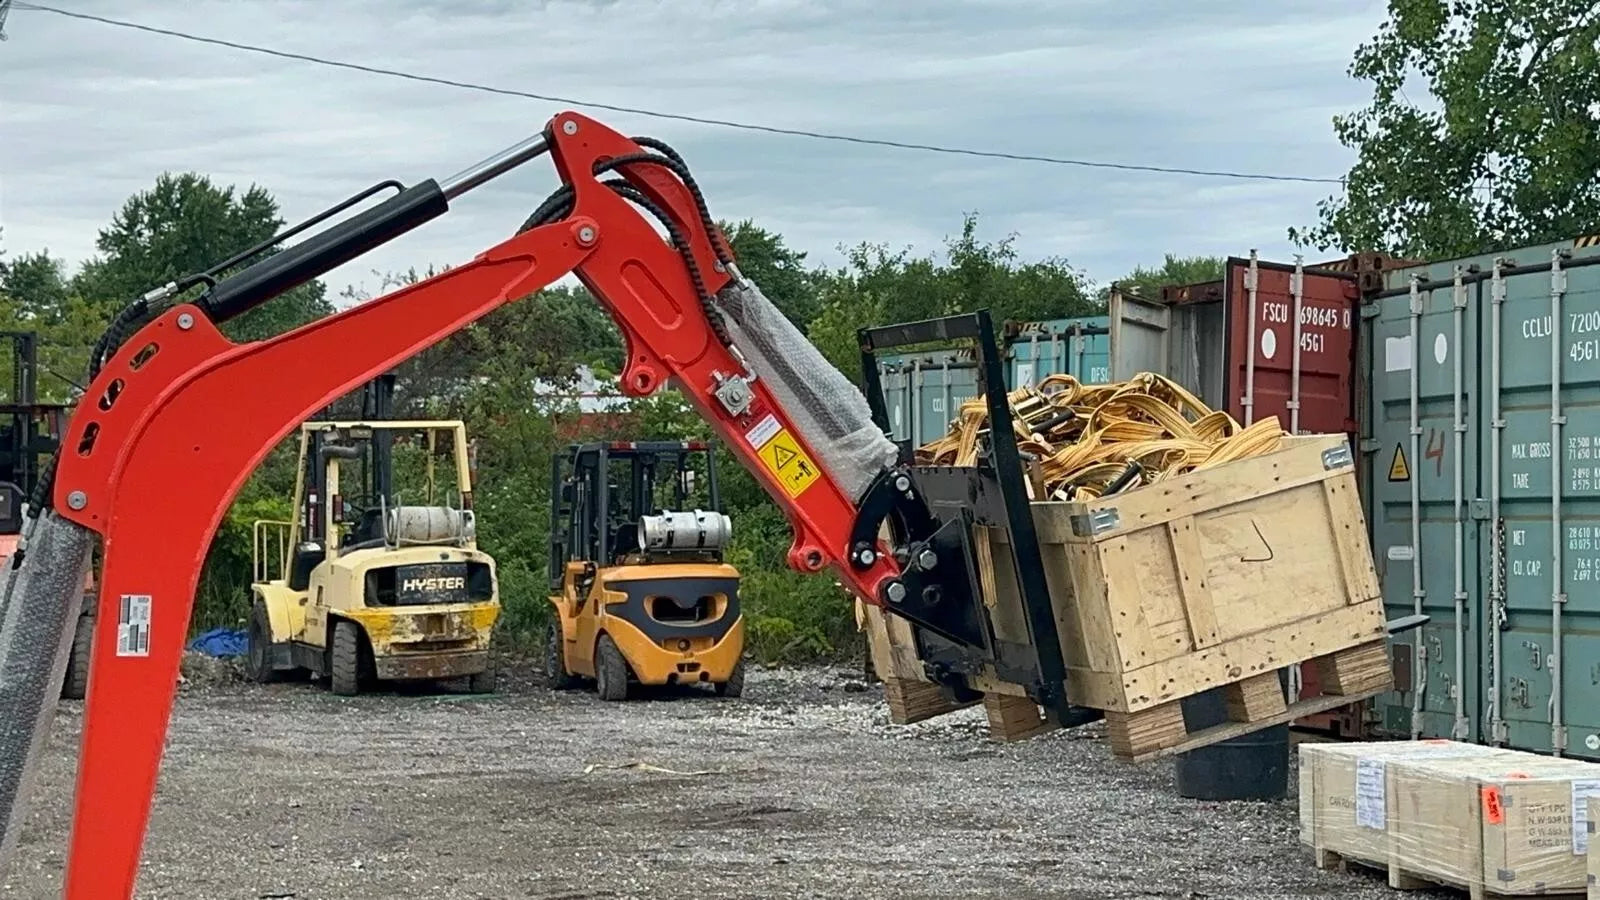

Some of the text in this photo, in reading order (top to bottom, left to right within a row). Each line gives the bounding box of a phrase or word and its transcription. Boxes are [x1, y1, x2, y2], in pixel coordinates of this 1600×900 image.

[1263, 302, 1288, 323] FSCU
[1300, 306, 1337, 328] 698645
[1523, 310, 1600, 338] CCLU 7200
[1300, 332, 1324, 353] 45G1
[1570, 339, 1599, 362] 45G1
[1425, 428, 1445, 477] 4
[1530, 442, 1551, 458] GROSS
[1512, 472, 1529, 489] TARE
[403, 577, 464, 592] HYSTER
